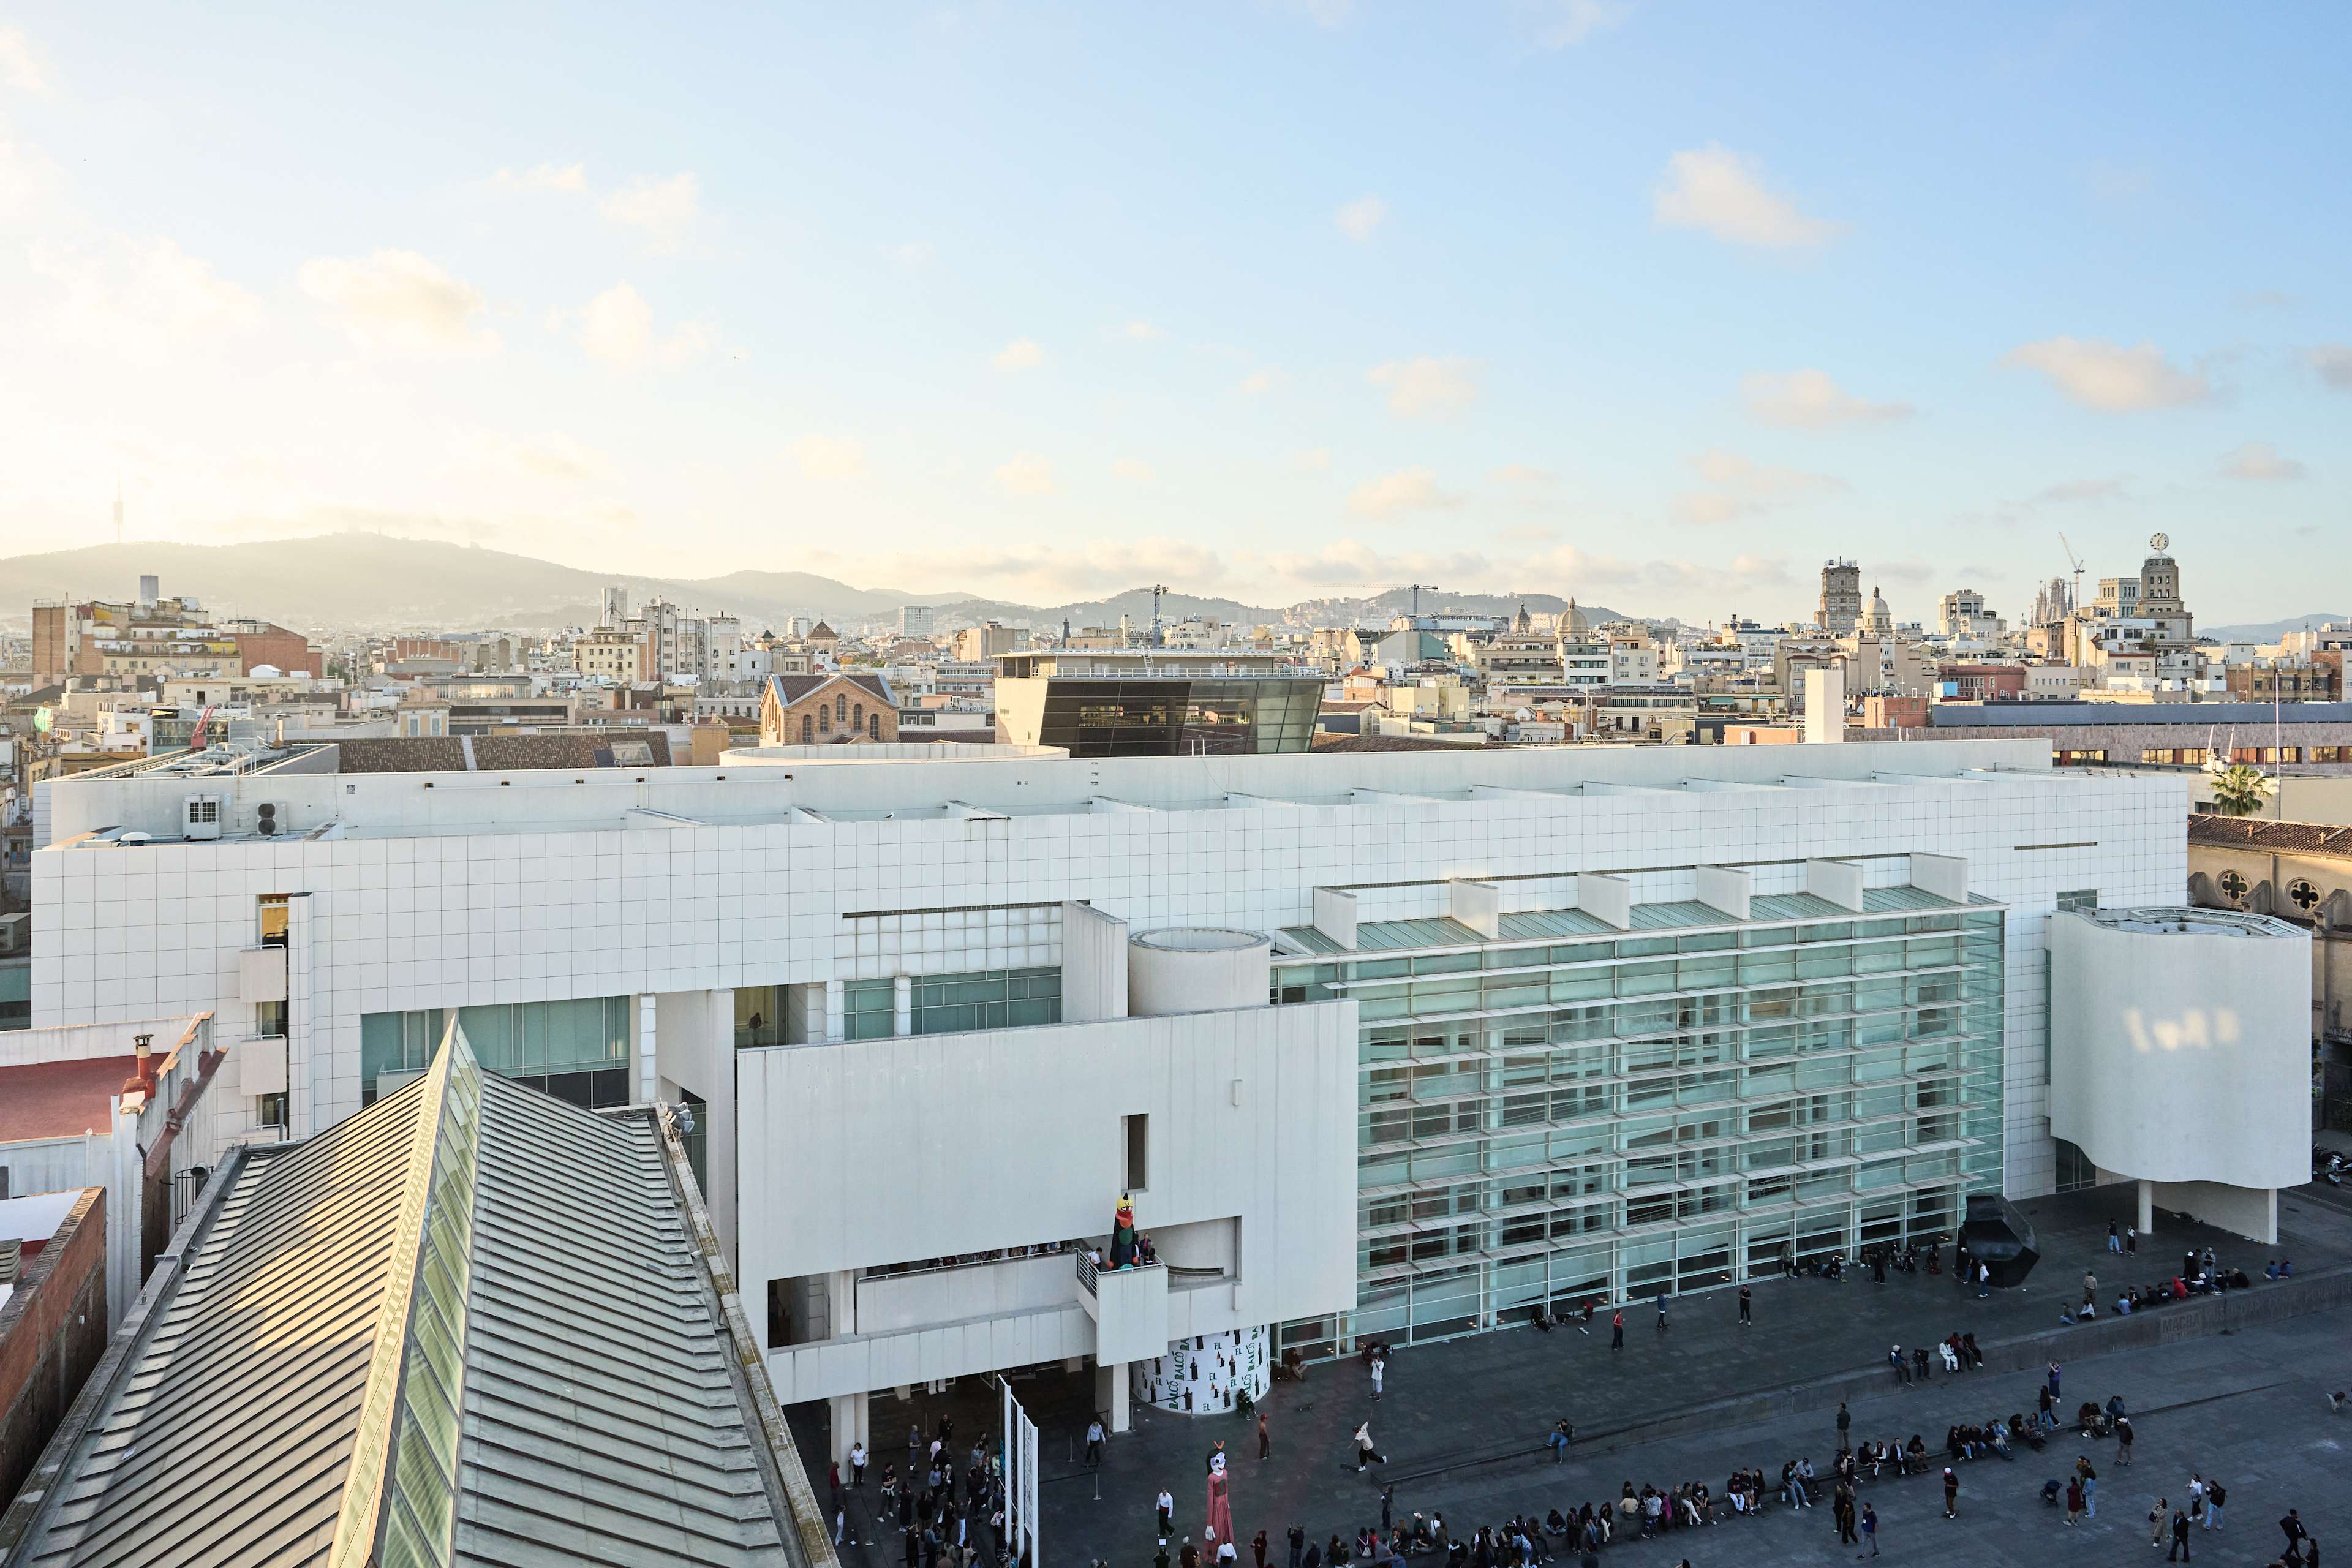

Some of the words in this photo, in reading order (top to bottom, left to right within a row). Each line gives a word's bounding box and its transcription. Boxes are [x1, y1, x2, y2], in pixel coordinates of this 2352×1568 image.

[1172, 1351, 1184, 1381] BALCÓ
[1245, 1343, 1255, 1371] BALCÓ
[1156, 1377, 1163, 1386] EL
[1166, 1379, 1178, 1410] BALCÓ
[1242, 1374, 1251, 1398] ALCÓ
